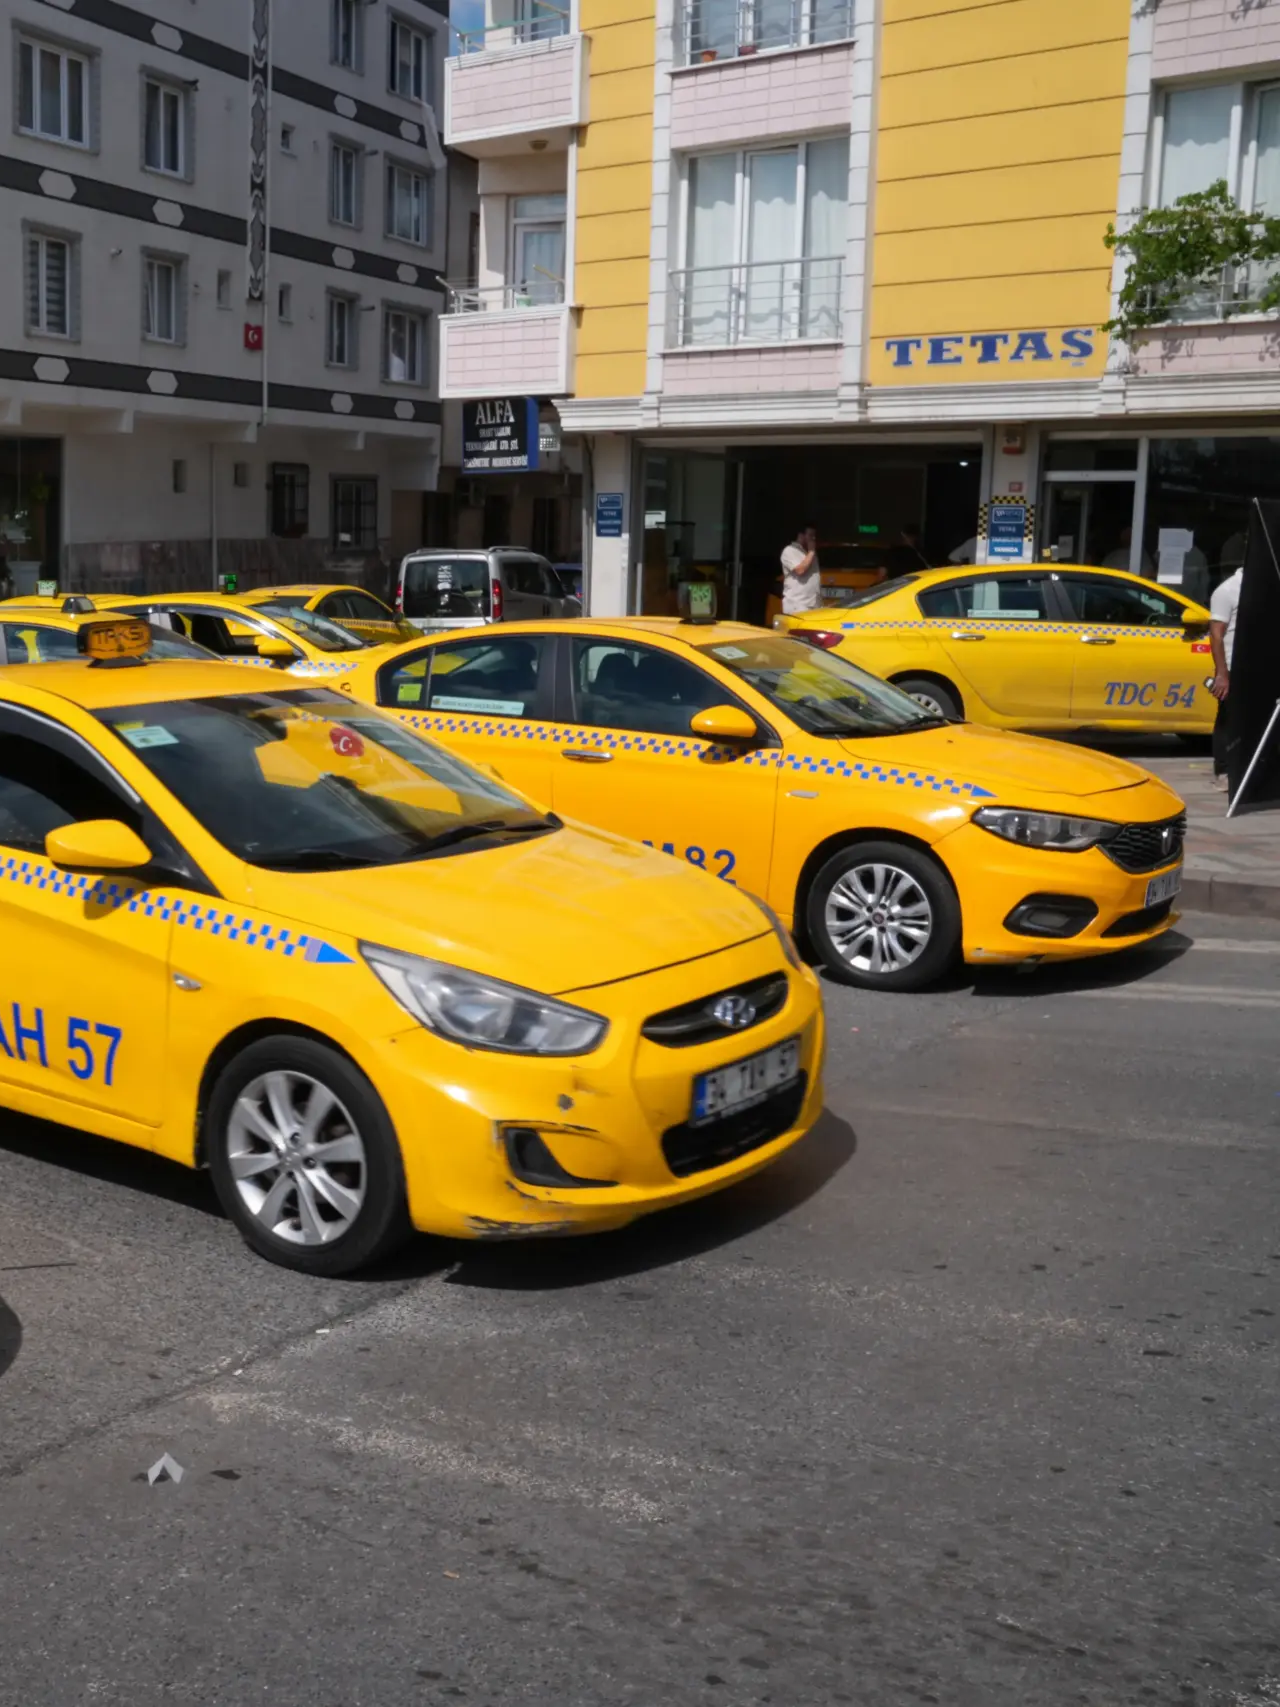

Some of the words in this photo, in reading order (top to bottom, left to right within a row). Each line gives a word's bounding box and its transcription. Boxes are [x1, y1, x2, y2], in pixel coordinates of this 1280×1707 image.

[475, 400, 515, 426] ALFA
[1104, 681, 1157, 706] TDC
[1163, 682, 1196, 708] 54
[67, 1016, 123, 1087] 57
